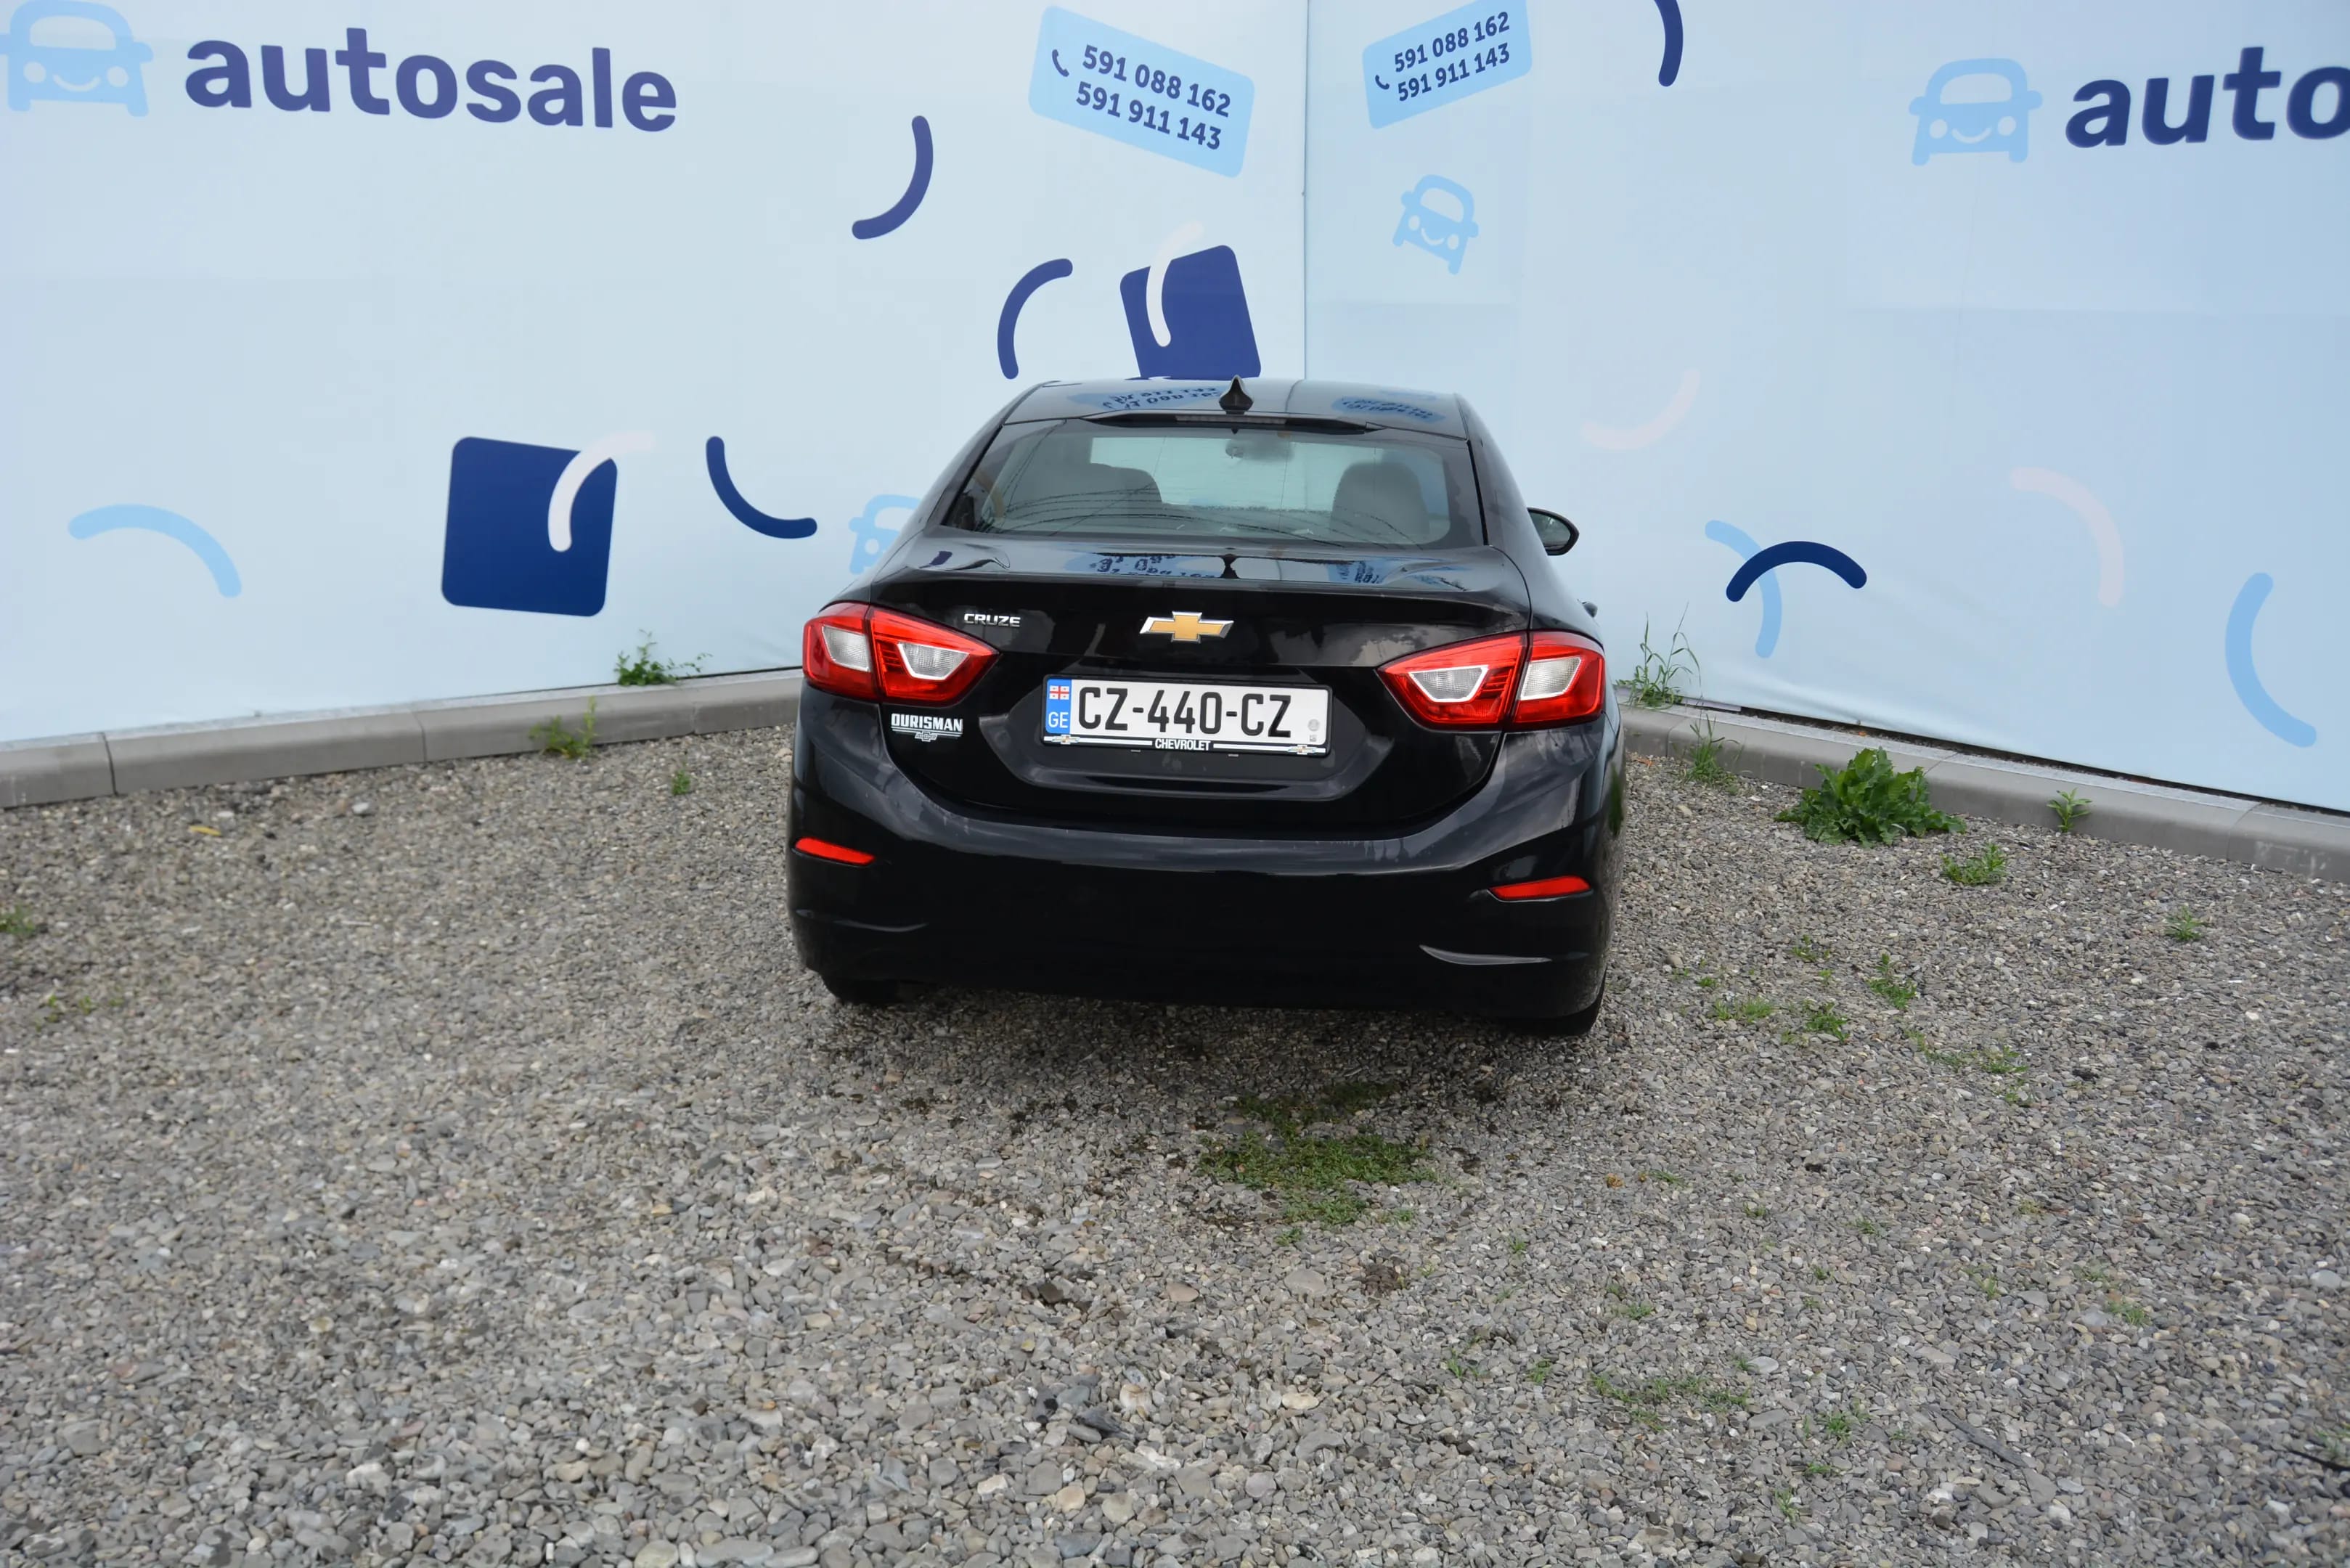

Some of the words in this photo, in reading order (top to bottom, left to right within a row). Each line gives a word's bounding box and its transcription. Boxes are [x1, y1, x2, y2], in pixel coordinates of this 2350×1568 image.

[1394, 44, 1428, 73] 591
[1432, 28, 1469, 58] 088
[1474, 11, 1510, 43] 162
[1398, 73, 1432, 102] 591
[1435, 58, 1470, 88] 911
[1474, 42, 1510, 74] 143
[185, 27, 677, 132] autosale
[1082, 44, 1127, 82] 591
[1135, 64, 1182, 99] 088
[1186, 83, 1231, 118] 162
[2065, 46, 2350, 148] auto
[1076, 81, 1121, 118] 591
[1127, 99, 1171, 135] 911
[1177, 116, 1222, 150] 143
[963, 613, 1021, 627] CRUZE
[891, 713, 963, 732] OURISMAN
[1048, 711, 1069, 729] GE
[1078, 686, 1292, 738] CZ-440-CZ
[1154, 738, 1211, 751] CHEVROLET
